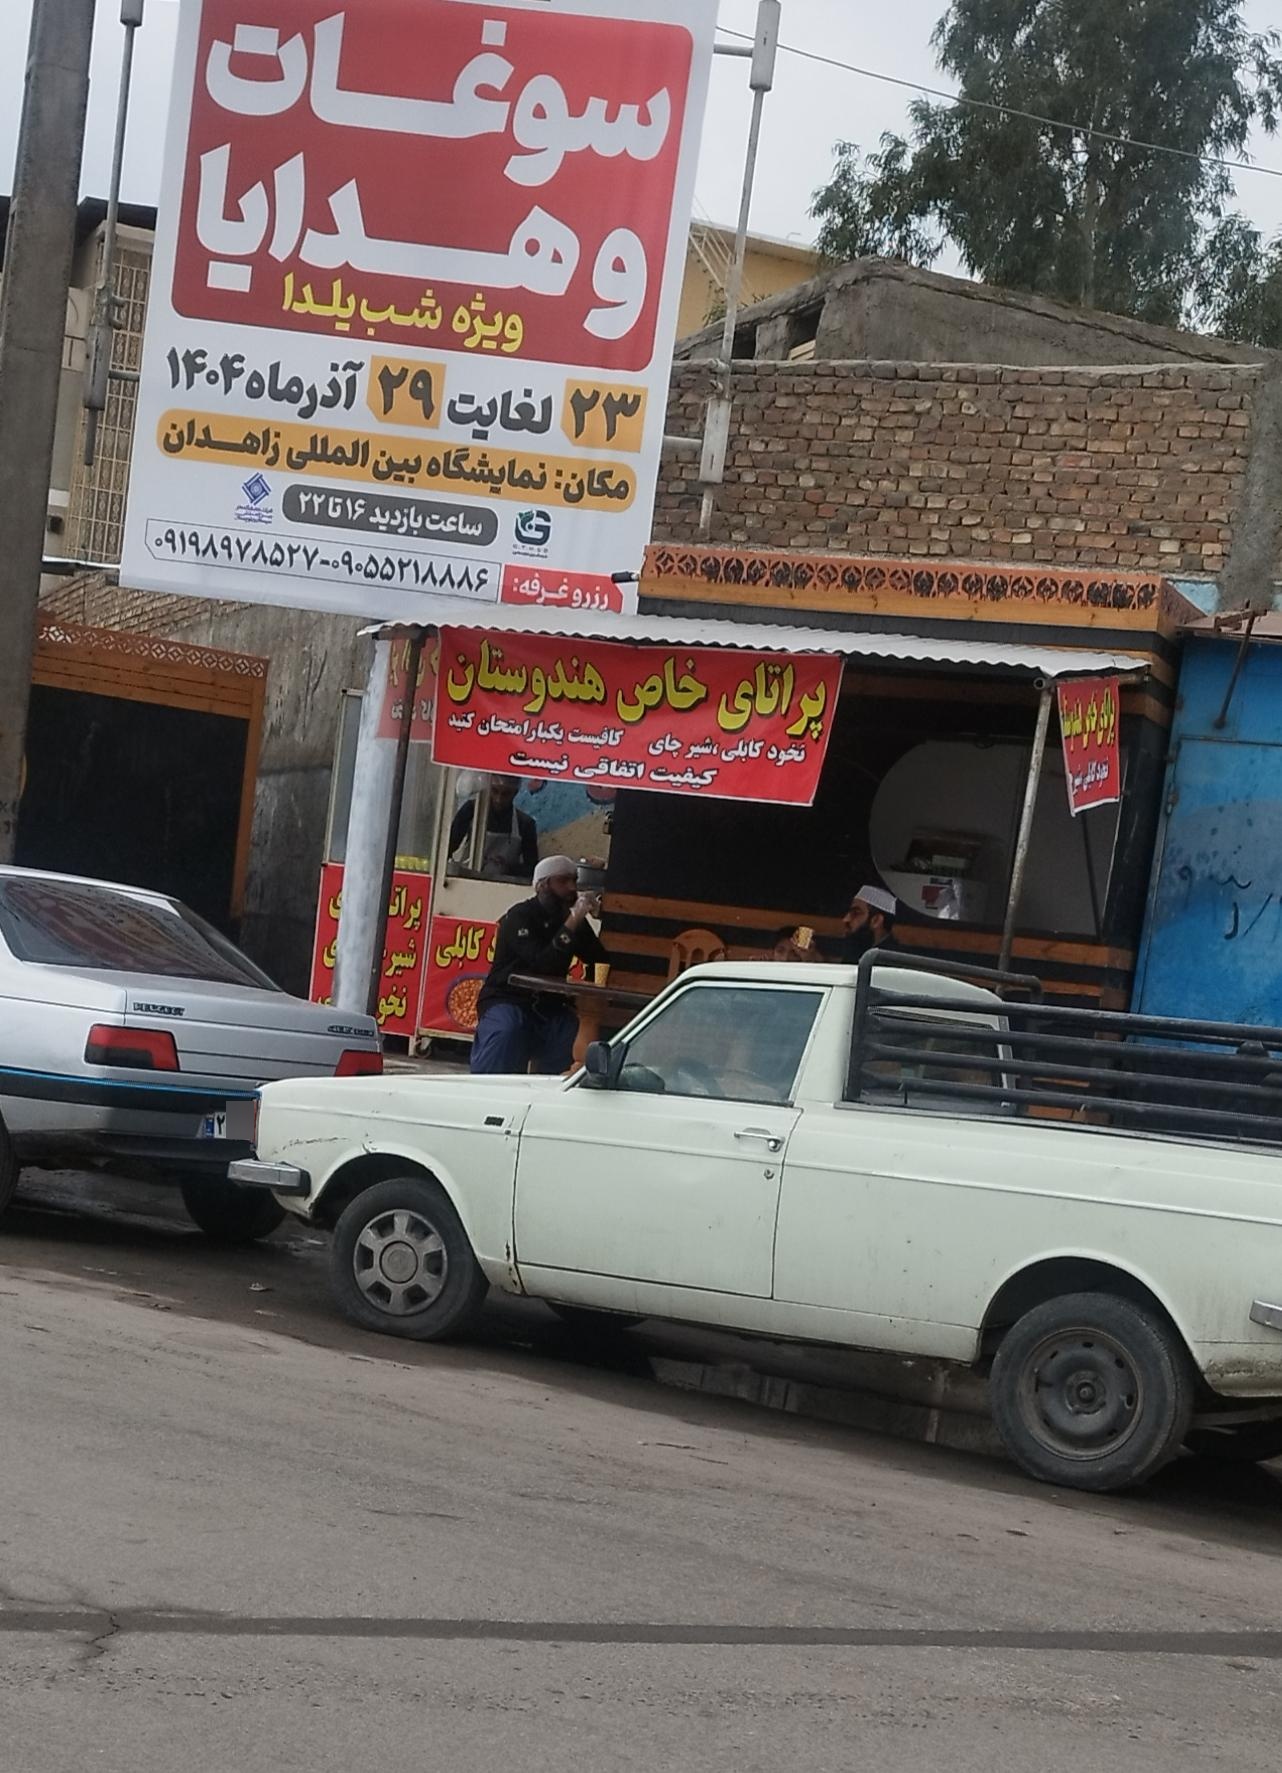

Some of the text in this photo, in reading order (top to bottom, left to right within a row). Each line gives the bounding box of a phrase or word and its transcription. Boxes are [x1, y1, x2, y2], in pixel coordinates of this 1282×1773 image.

[206, 12, 671, 187] سوغات
[281, 272, 524, 353] ویژه شب یلدا
[166, 346, 246, 396] ۱۴۰۴
[377, 364, 435, 421] ۲۹
[447, 388, 553, 441] لغایت
[569, 388, 642, 442] ۲۳
[162, 419, 630, 503] مکان: نمایشگاه بین المللی زاهدان
[298, 491, 326, 516] ۲۲
[328, 495, 342, 518] تا
[346, 497, 367, 521] ۱۶
[368, 505, 423, 535] بازدید
[424, 512, 483, 537] ساعت
[512, 572, 609, 610] رزرو غرفه:
[447, 639, 607, 713] هندوستان
[616, 656, 708, 723] خاص
[717, 661, 827, 740] پراتای
[447, 711, 475, 731] کنید
[567, 727, 624, 749] کافیست
[648, 732, 682, 759] چای
[720, 738, 765, 762] کابلی
[766, 743, 806, 767] نخود
[508, 751, 718, 788] کیفیت اتفاقی نیست
[435, 924, 486, 969] کابلی
[377, 985, 407, 1026] نخو
